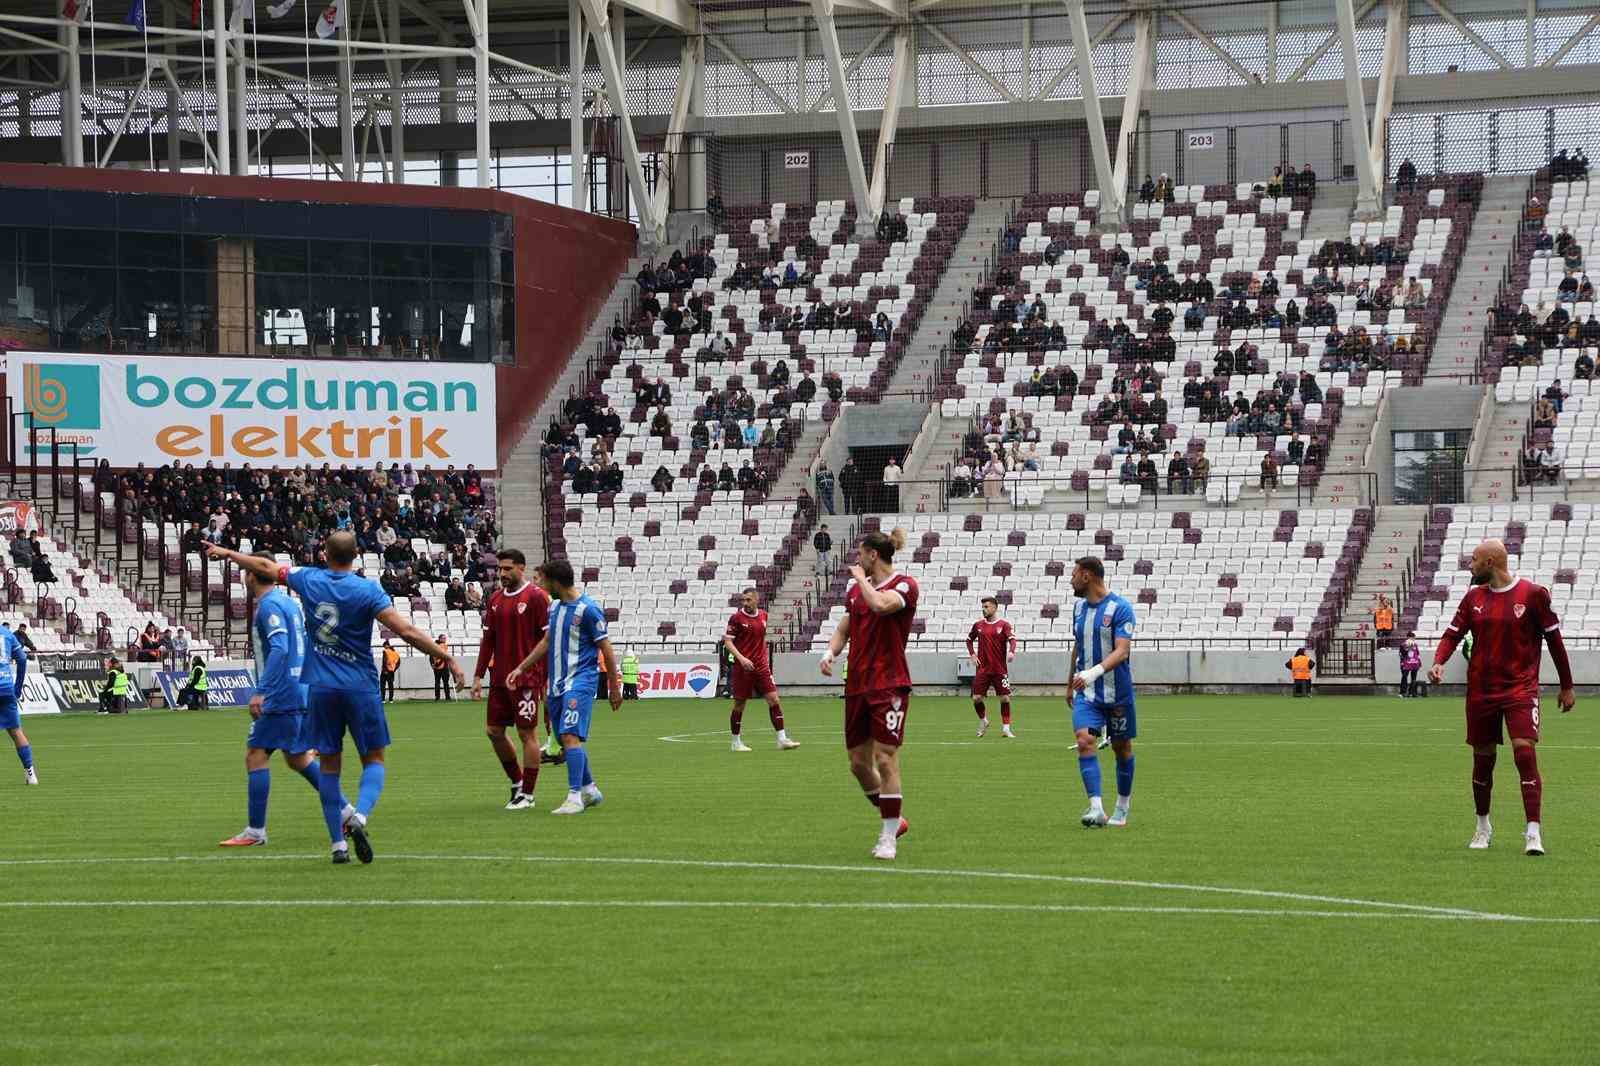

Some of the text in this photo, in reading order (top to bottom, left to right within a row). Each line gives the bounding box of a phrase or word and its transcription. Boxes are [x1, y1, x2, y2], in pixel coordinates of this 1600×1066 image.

[1190, 136, 1213, 146] 203
[786, 155, 808, 165] 202
[126, 364, 478, 412] bozduman
[155, 414, 450, 460] elektrik
[314, 601, 338, 643] 2
[519, 701, 537, 716] 20
[564, 709, 580, 725] 20
[885, 710, 905, 731] 97
[1111, 717, 1128, 731] 52
